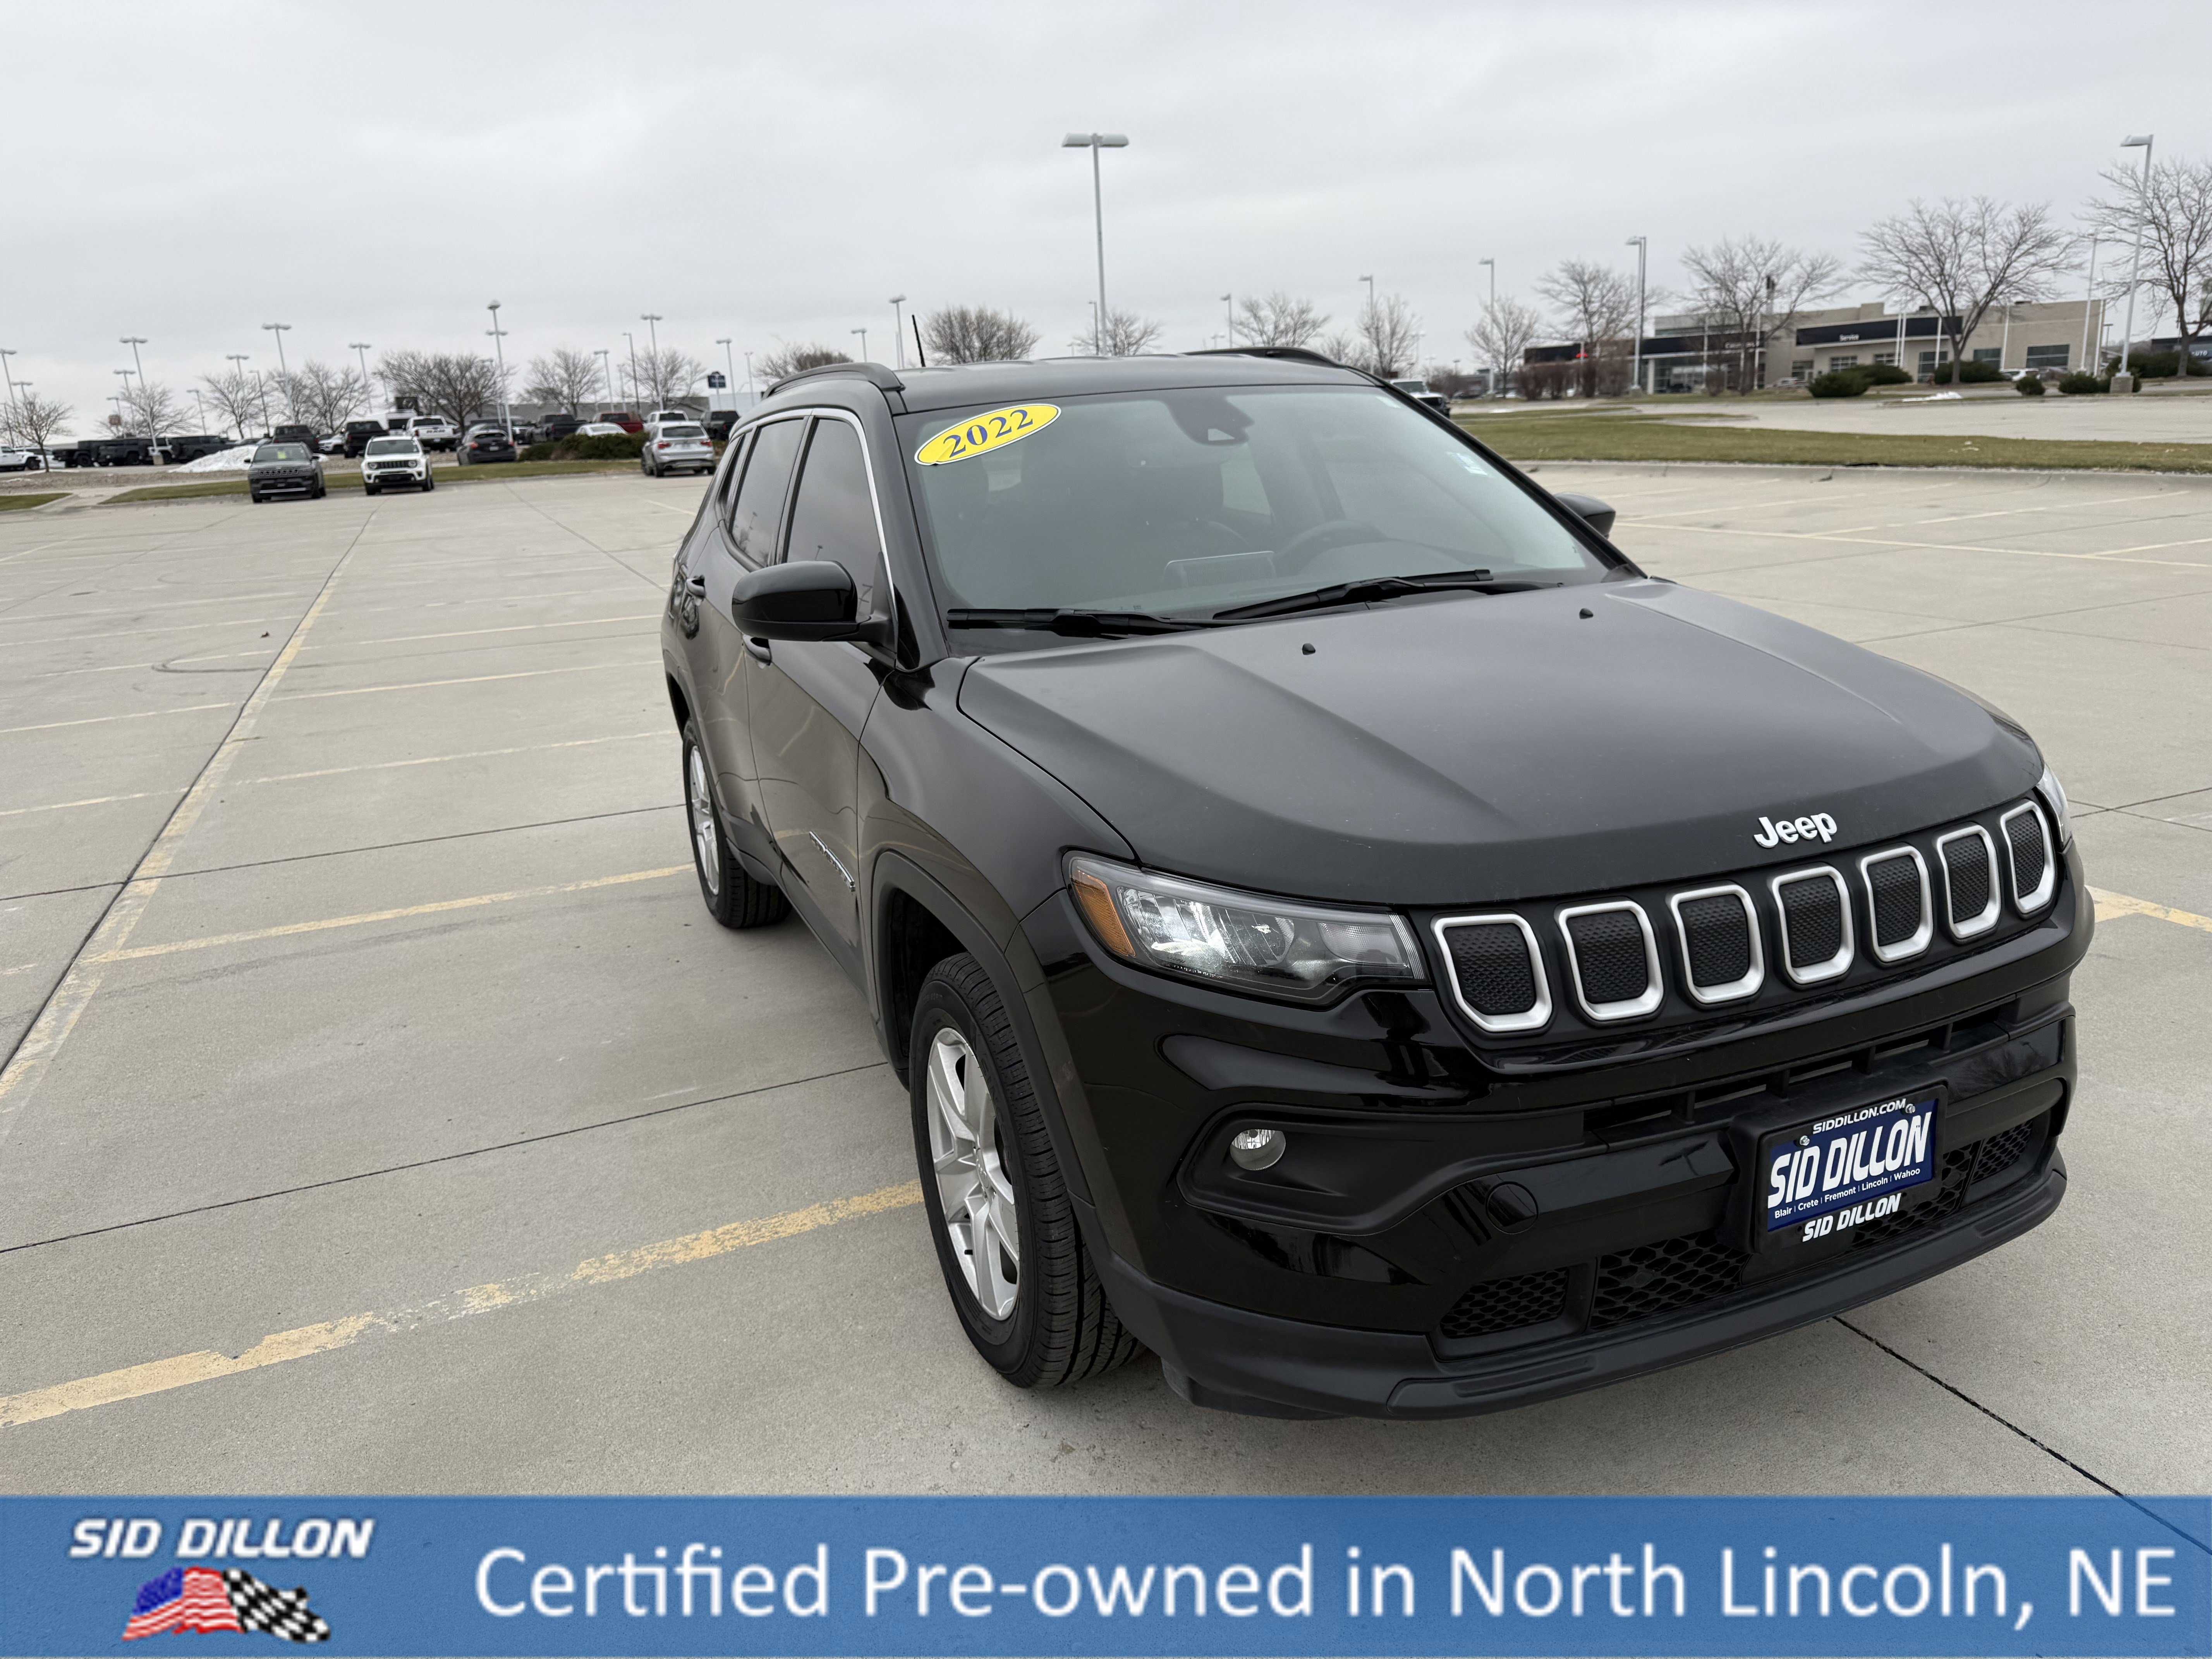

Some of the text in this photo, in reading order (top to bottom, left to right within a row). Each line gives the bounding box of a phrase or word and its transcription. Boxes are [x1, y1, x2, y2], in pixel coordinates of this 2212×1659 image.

[943, 409, 1033, 458] 2022
[1753, 812, 1838, 848] Jeep
[1813, 1098, 1906, 1134] SIDDILLON.COM
[1768, 1111, 1932, 1209] SID DILLON
[1774, 1168, 1920, 1219] Blair Crete Fremont Lincoln Wahoo
[1802, 1193, 1901, 1242] SID DILLON
